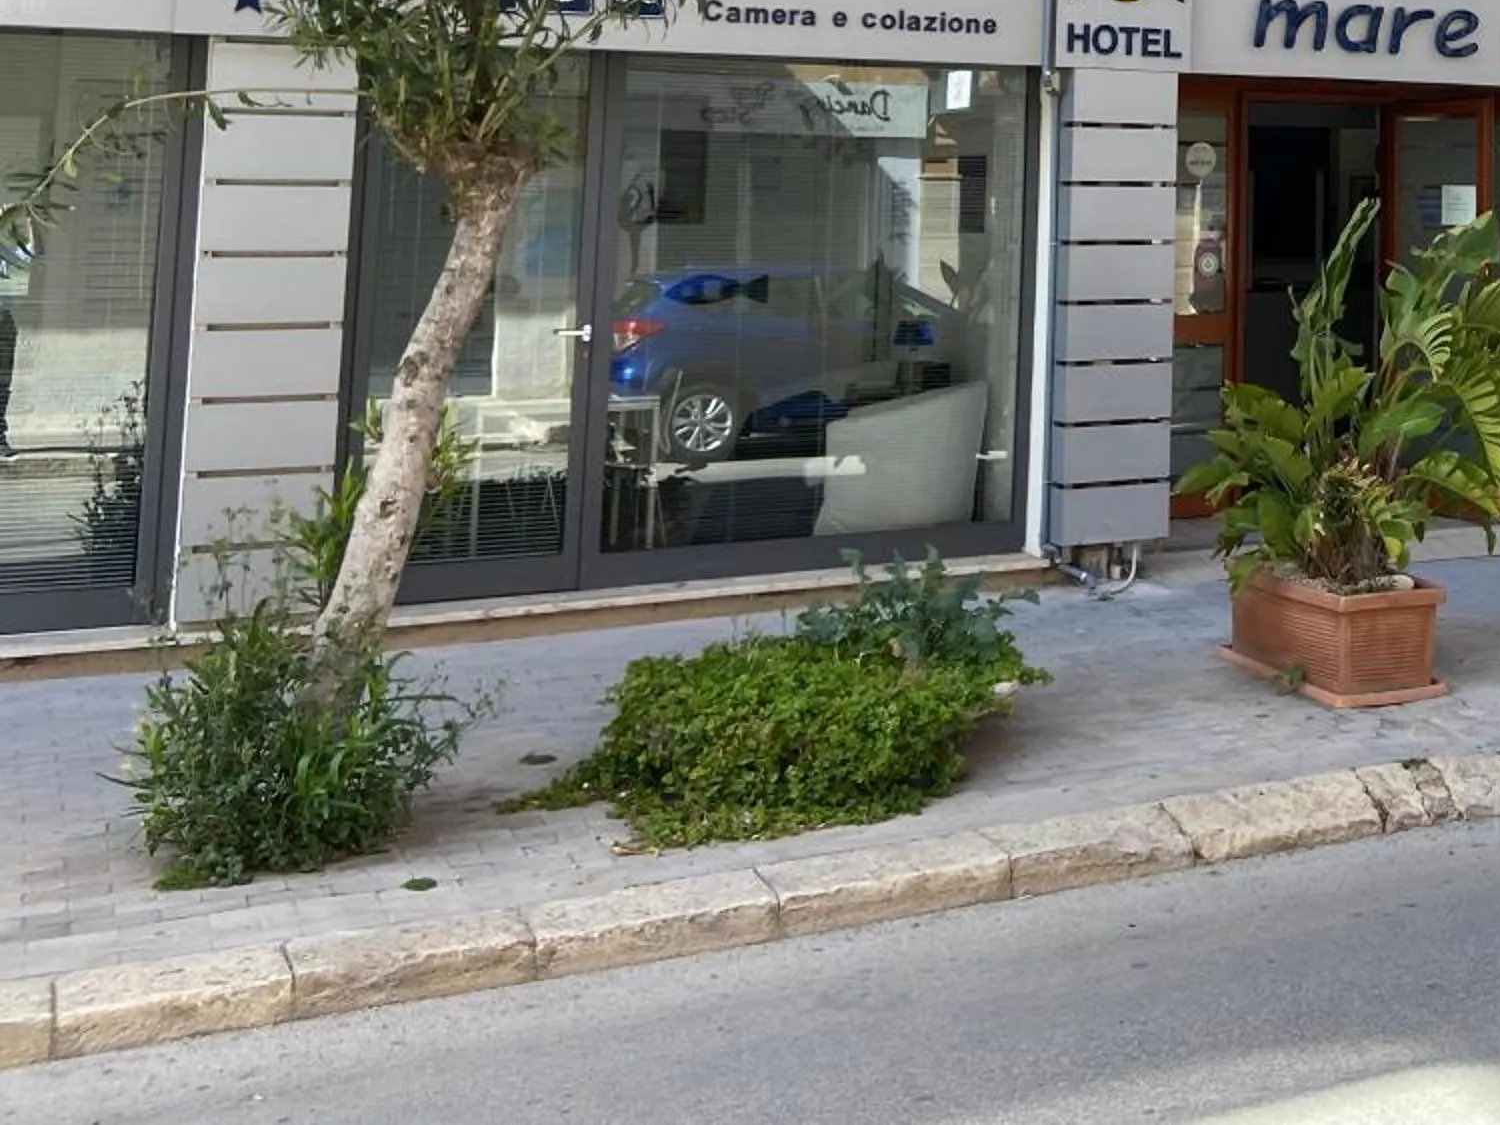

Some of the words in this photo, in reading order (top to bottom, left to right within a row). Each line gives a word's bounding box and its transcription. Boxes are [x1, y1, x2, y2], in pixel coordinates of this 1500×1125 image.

[704, 0, 817, 27] Camera
[832, 10, 848, 28] e
[862, 7, 997, 35] colazione
[1066, 21, 1182, 59] HOTEL
